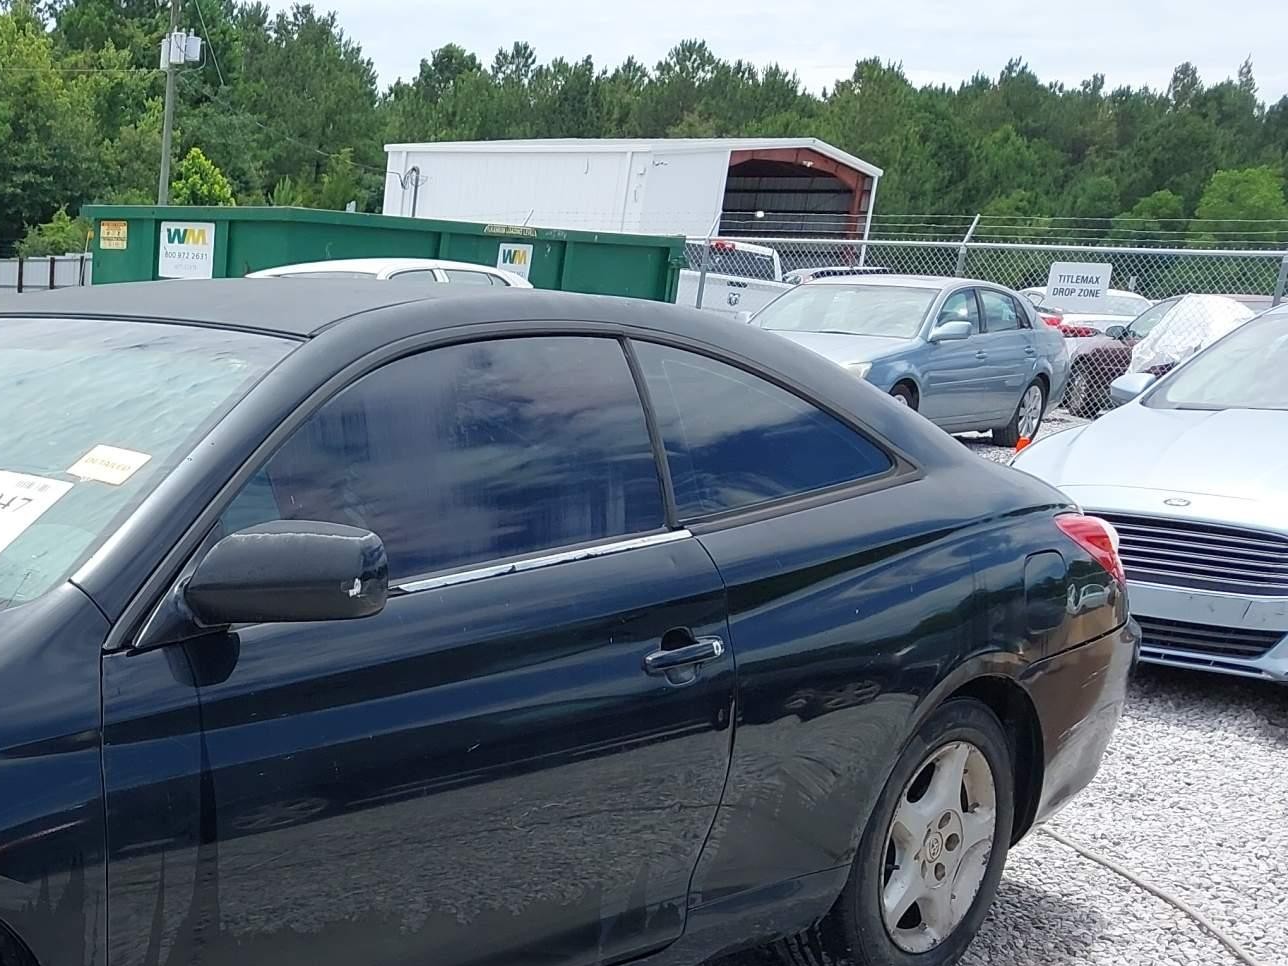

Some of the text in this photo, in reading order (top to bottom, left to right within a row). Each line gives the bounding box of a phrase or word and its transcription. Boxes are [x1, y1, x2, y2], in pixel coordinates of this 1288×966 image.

[167, 228, 208, 245] WM
[191, 252, 208, 260] 2631
[502, 248, 527, 264] WM
[1058, 274, 1101, 284] TITLEMAX
[1052, 287, 1101, 297] DROP ZONE
